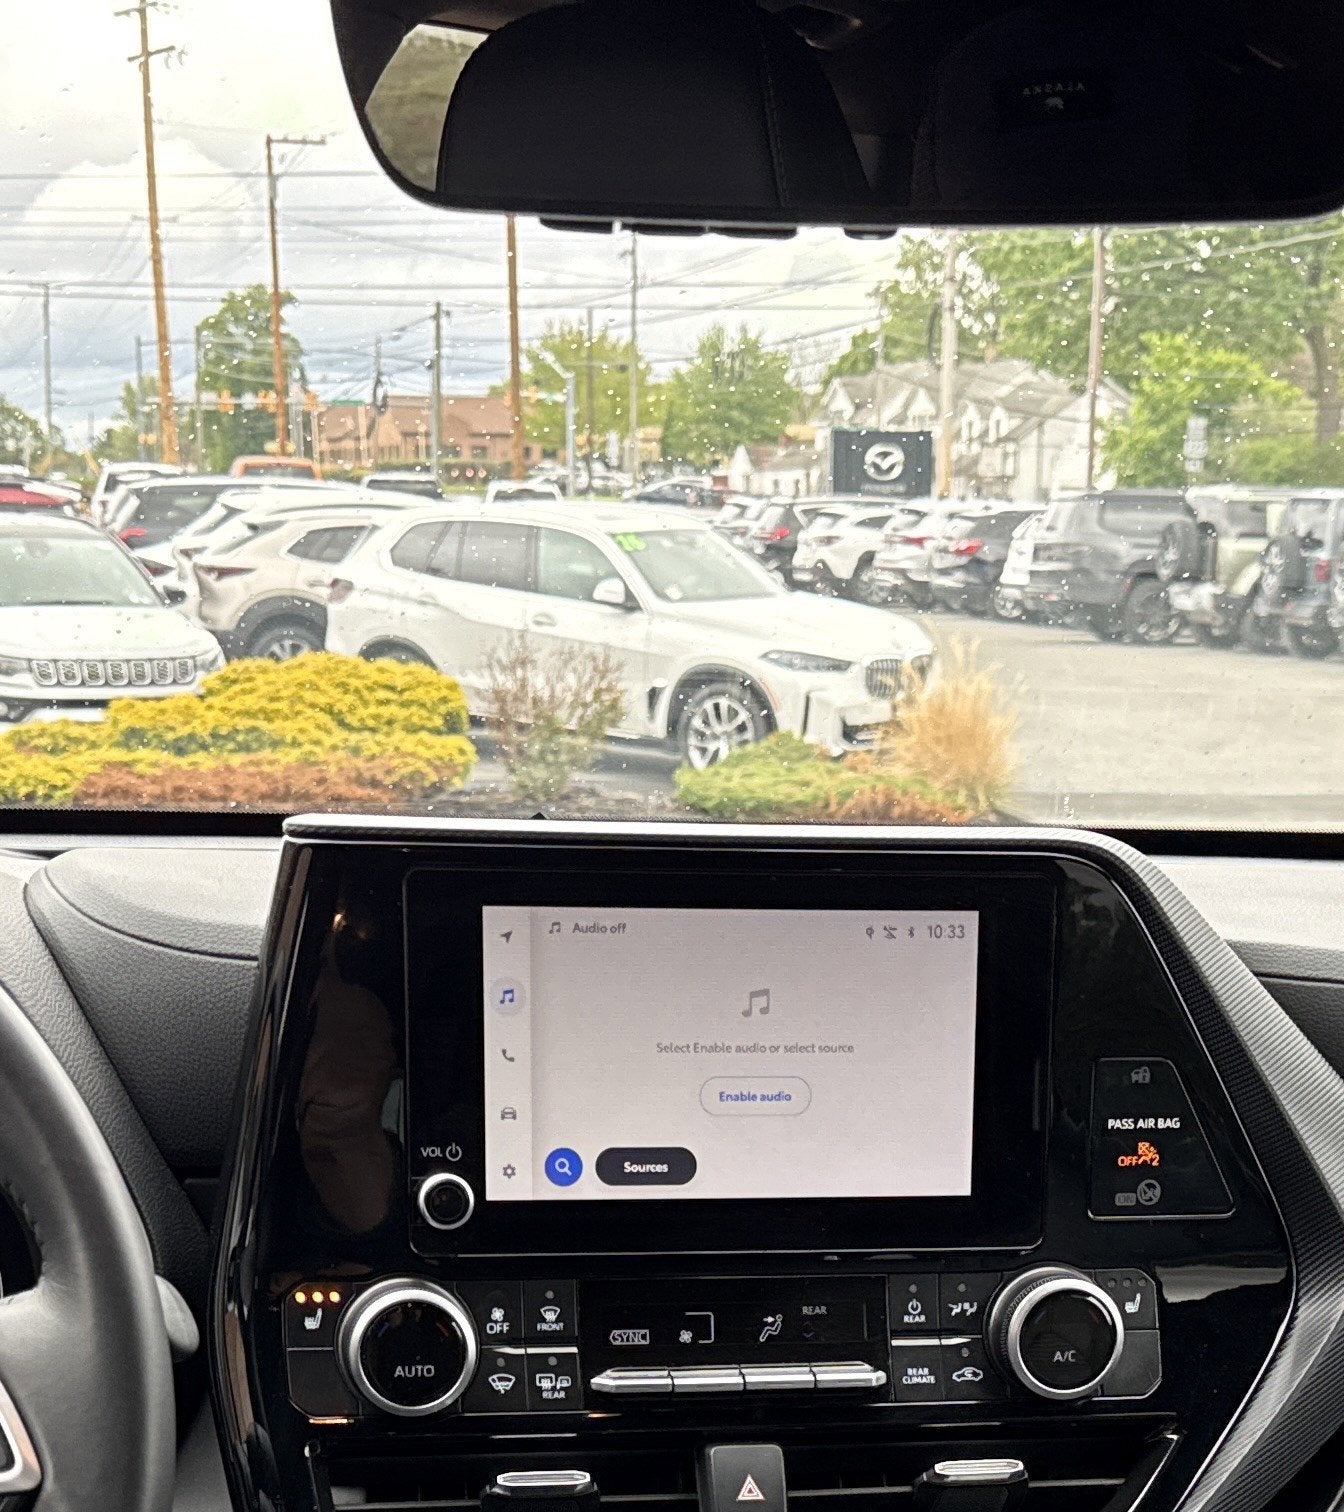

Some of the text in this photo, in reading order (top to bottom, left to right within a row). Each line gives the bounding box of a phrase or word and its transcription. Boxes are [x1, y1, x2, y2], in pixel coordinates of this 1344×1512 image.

[572, 921, 627, 935] Audio off
[927, 924, 966, 941] 10:33
[656, 1042, 854, 1054] Select Enable audio or select source
[719, 1091, 792, 1103] Enable audio
[1107, 1117, 1181, 1130] PASS AIR BAG
[420, 1146, 443, 1158] VOL
[623, 1159, 669, 1175] Sources
[1117, 1155, 1138, 1167] OFF
[801, 1305, 827, 1316] REAR
[903, 1314, 926, 1323] REAR
[486, 1322, 510, 1335] OFF
[536, 1322, 564, 1331] FRONT
[613, 1331, 648, 1343] SYNC
[1052, 1350, 1077, 1363] A/C
[393, 1364, 435, 1379] AUTO
[906, 1367, 929, 1376] REAR
[902, 1376, 936, 1385] CLIMATE
[542, 1390, 565, 1399] REAR
